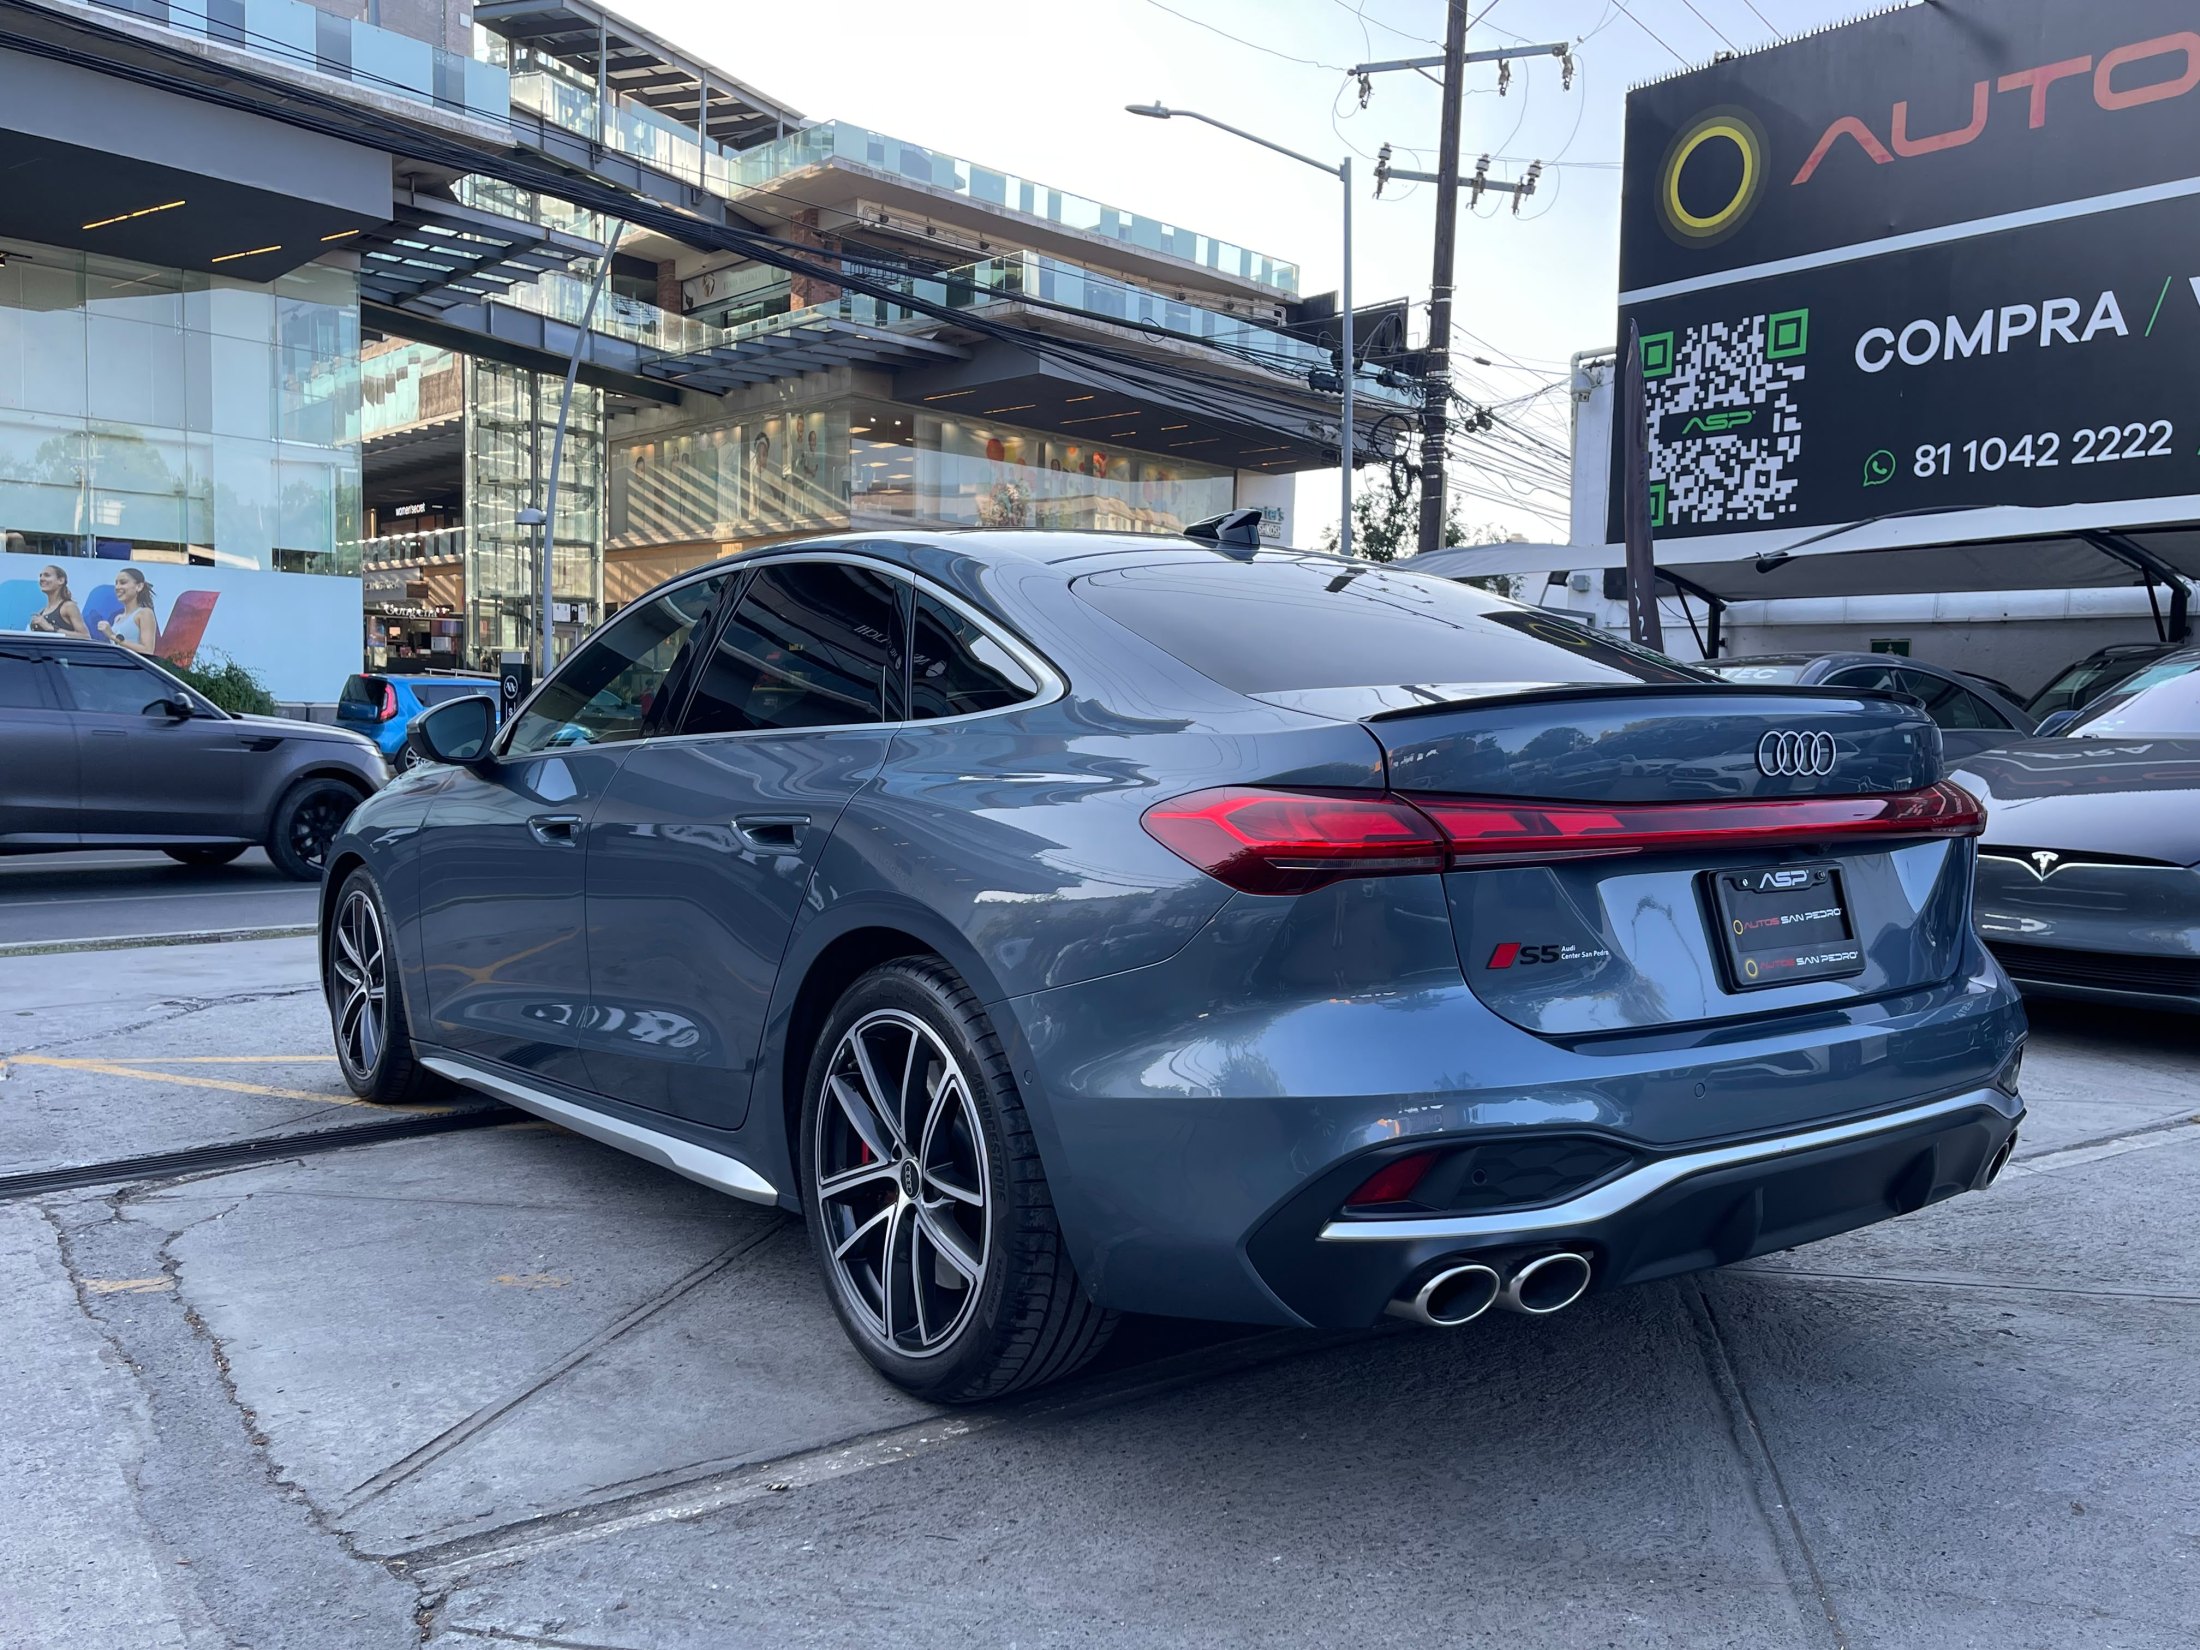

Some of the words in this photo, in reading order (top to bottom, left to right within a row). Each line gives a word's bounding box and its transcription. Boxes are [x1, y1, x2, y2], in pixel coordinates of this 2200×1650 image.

[1854, 290, 2129, 373] COMPRA
[1682, 410, 1753, 435] ASP
[1913, 443, 1951, 477] 81
[1963, 432, 2060, 472] 1042
[2071, 419, 2174, 465] 2222
[1759, 870, 1809, 889] ASP
[1744, 917, 1780, 930] AUTOS
[1780, 914, 1805, 925] SAN
[1805, 908, 1841, 920] PEDRO
[1519, 944, 1560, 965] S5
[1561, 944, 1576, 952] Audi
[1561, 952, 1580, 960] Center
[1593, 949, 1609, 957] Pedro
[1760, 957, 1795, 970] AUTOS
[1796, 956, 1820, 966] SAN
[1820, 951, 1857, 963] PEDRO
